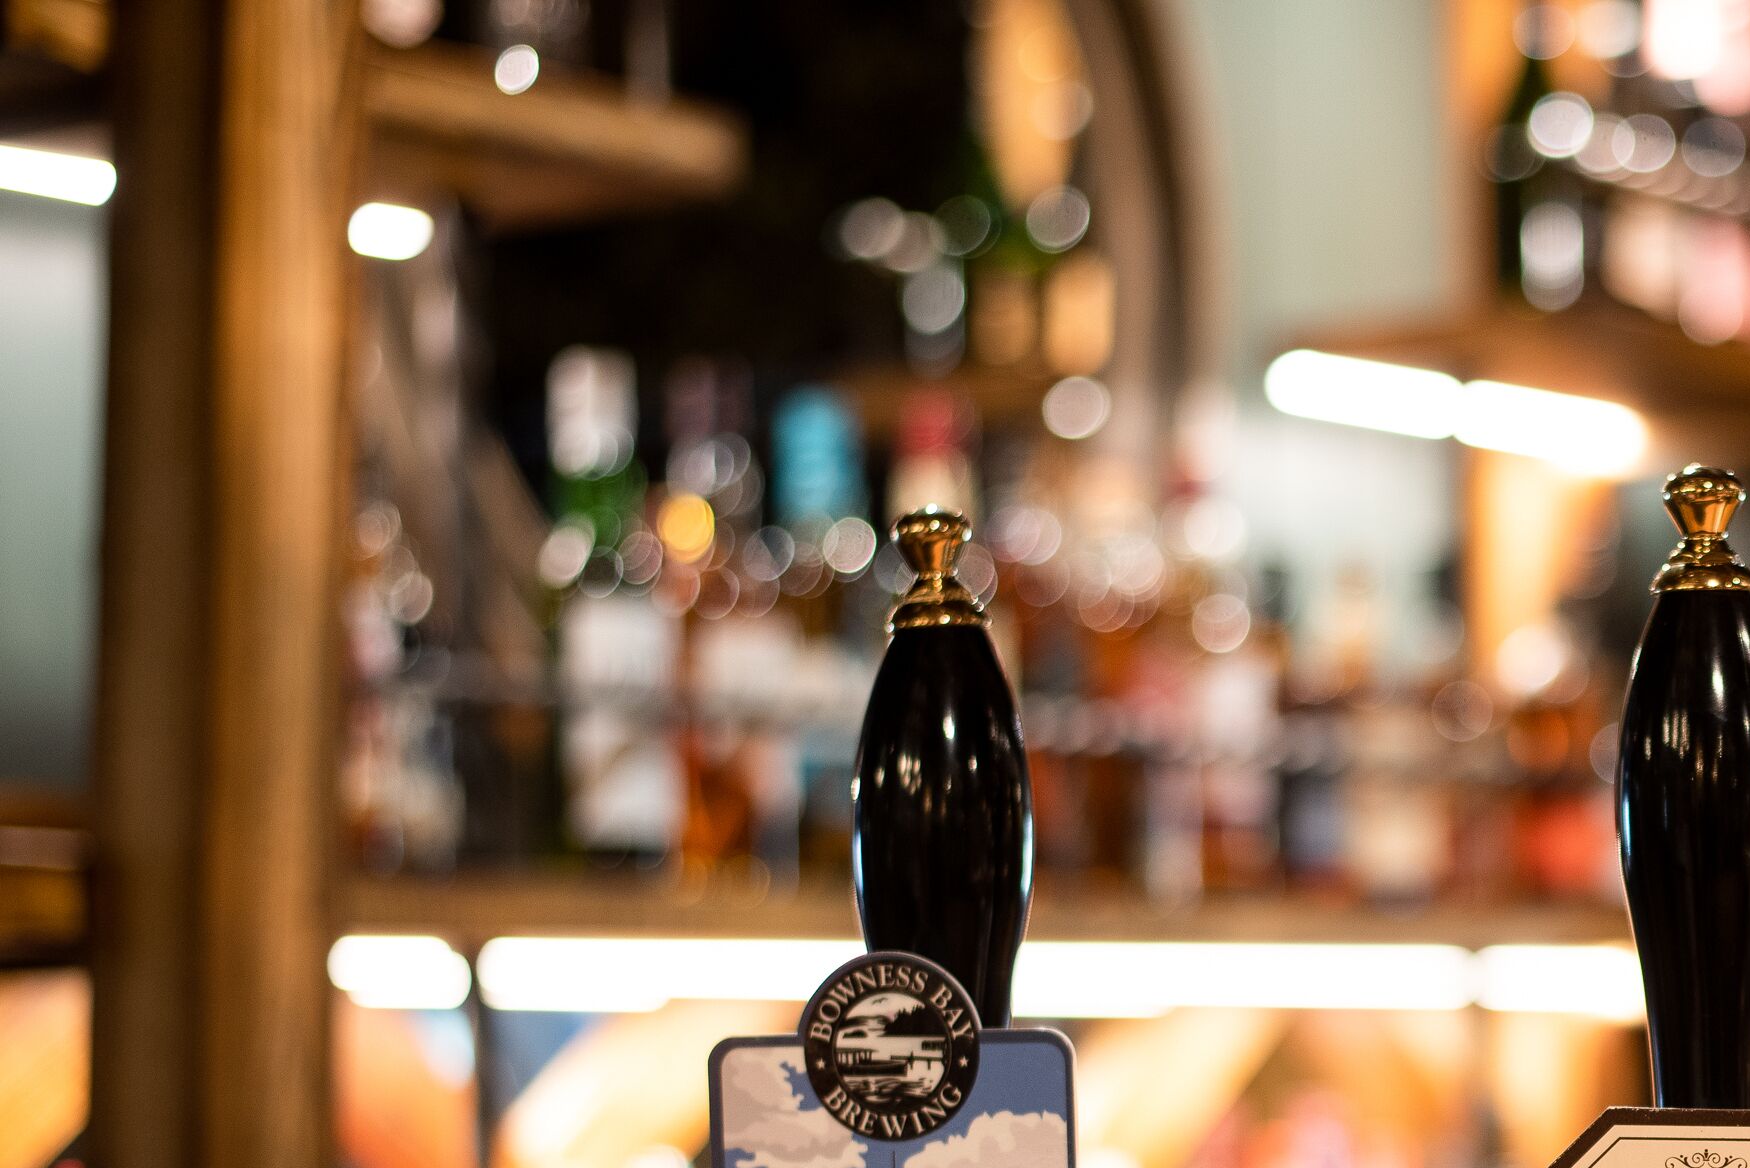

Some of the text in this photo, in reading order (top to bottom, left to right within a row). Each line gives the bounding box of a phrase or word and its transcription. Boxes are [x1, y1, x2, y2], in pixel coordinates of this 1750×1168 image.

[810, 964, 975, 1043] BOWNESS BAY
[823, 1083, 962, 1138] BREWING
